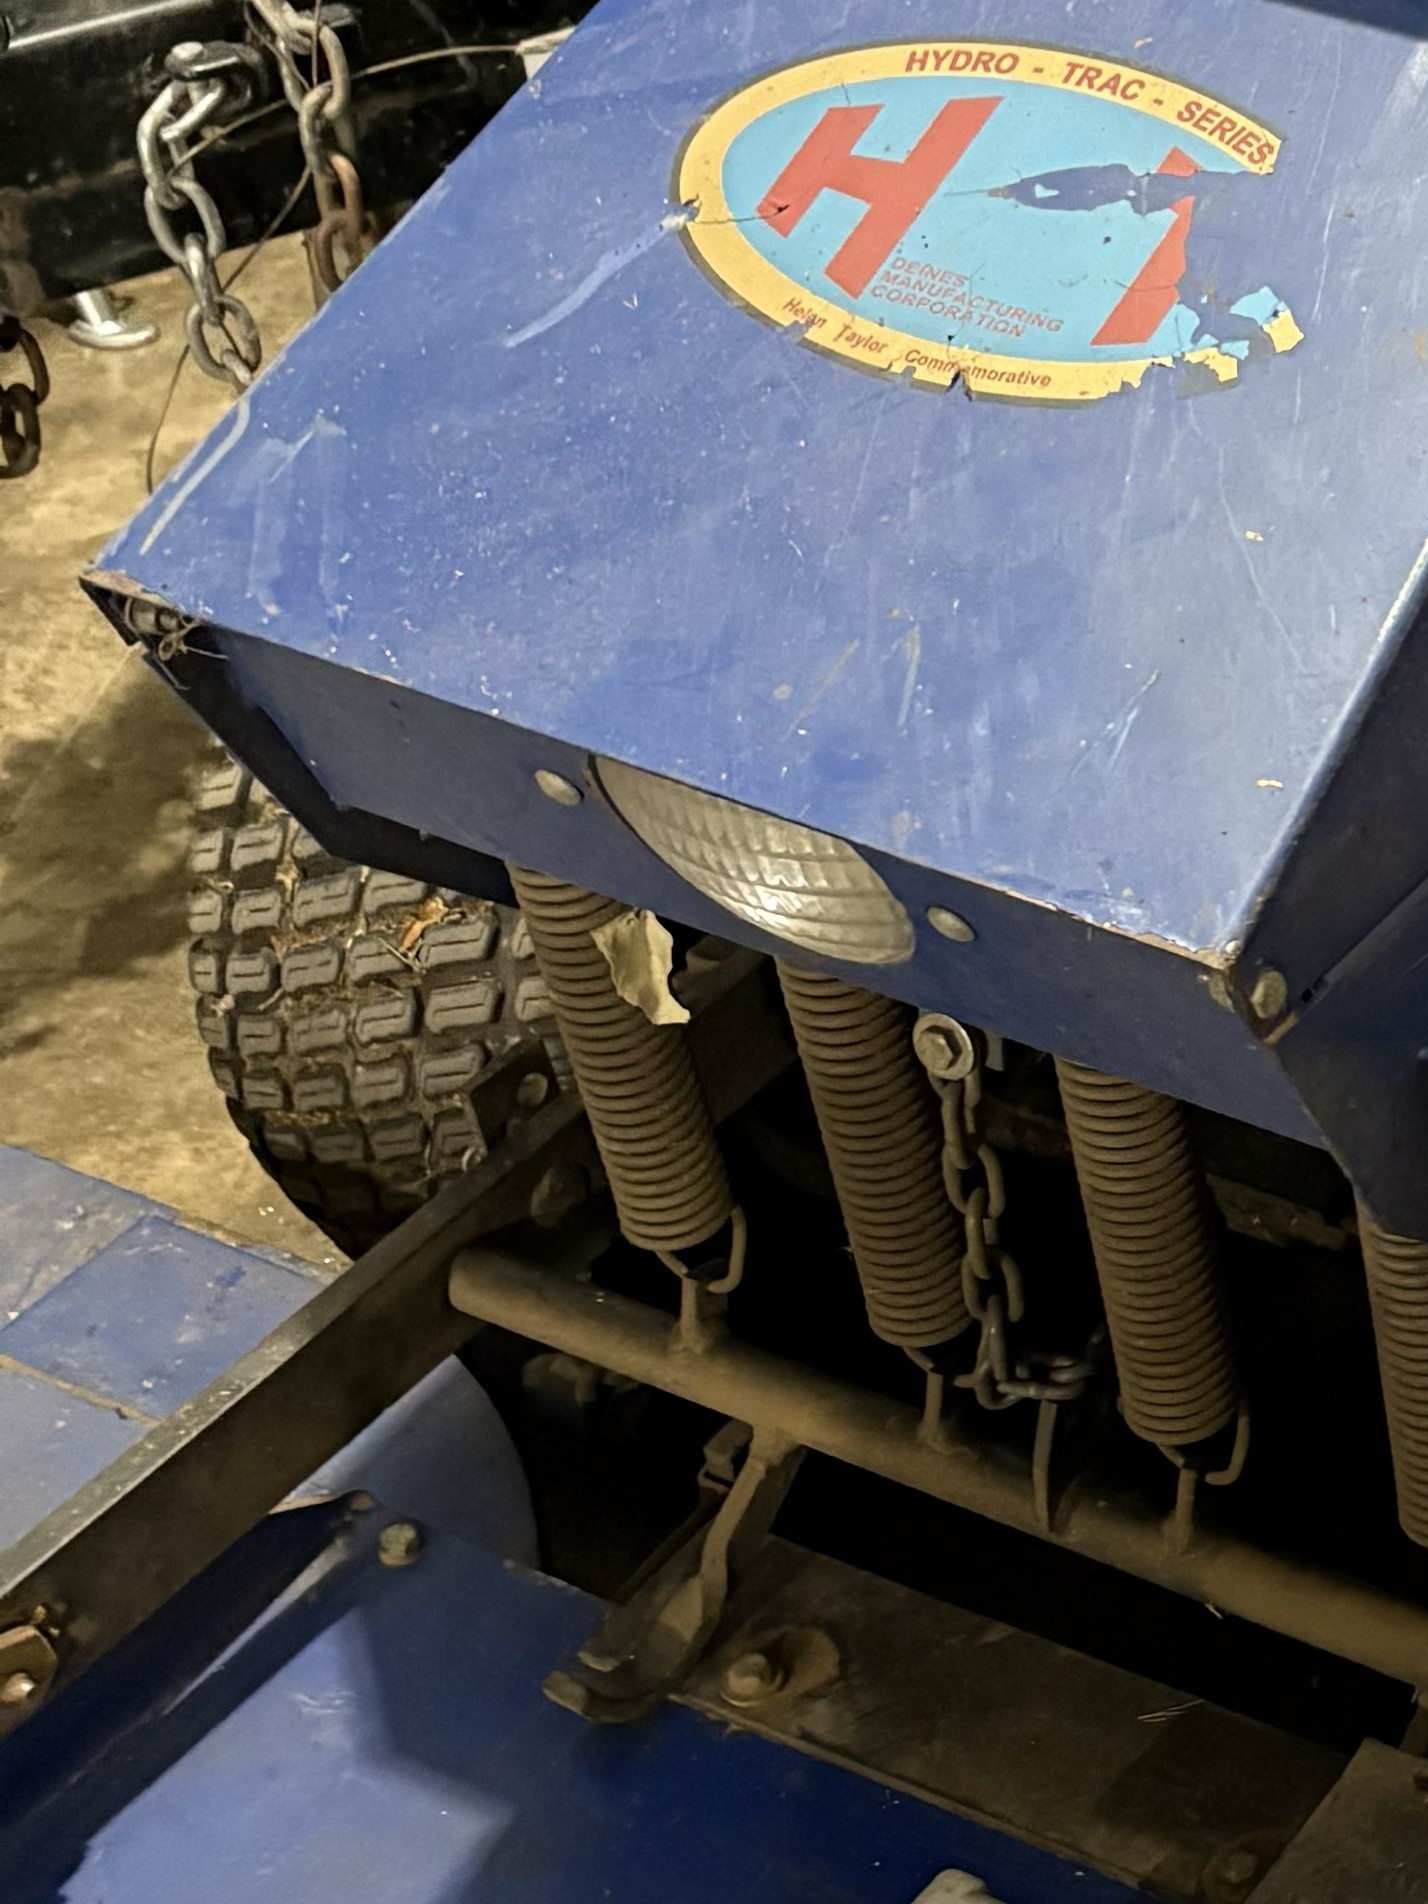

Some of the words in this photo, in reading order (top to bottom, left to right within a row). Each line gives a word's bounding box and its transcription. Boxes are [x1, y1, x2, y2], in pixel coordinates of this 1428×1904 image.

[905, 48, 1019, 78] HYDRO
[1062, 60, 1147, 100] TRAC
[1176, 100, 1276, 166] SERIES
[891, 256, 970, 287] DEINES
[870, 284, 1026, 338] CORPORATION
[881, 270, 1065, 333] MANUFACTURING
[833, 323, 889, 355] Taylor
